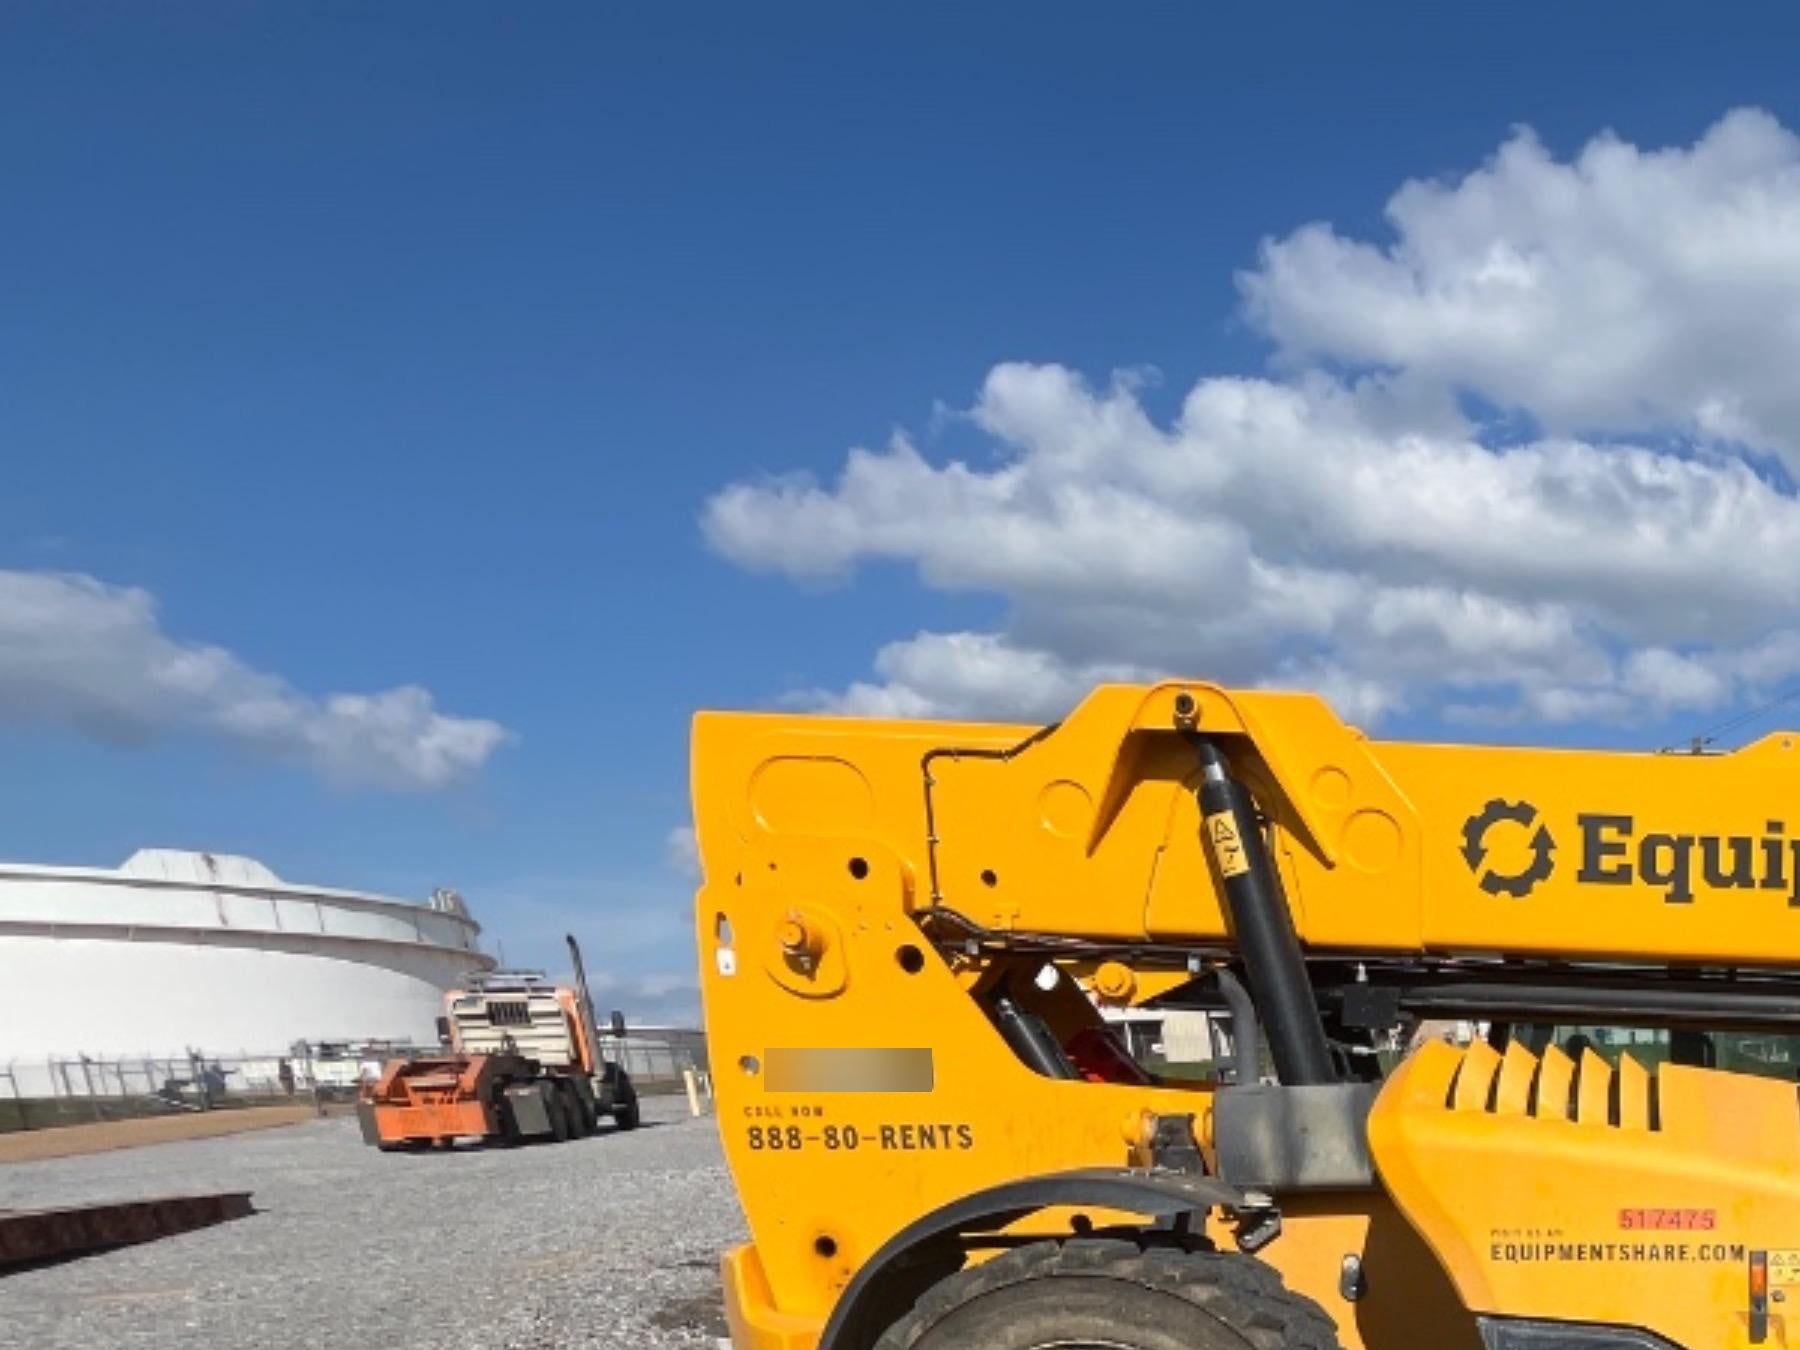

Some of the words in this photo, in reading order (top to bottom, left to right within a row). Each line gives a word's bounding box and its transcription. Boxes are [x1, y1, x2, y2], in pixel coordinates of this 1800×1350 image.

[747, 1125, 973, 1150] 888-80-RENTS
[1620, 1209, 1716, 1230] 517475
[1490, 1244, 1745, 1263] EQUIPMENTSHARE.COM
